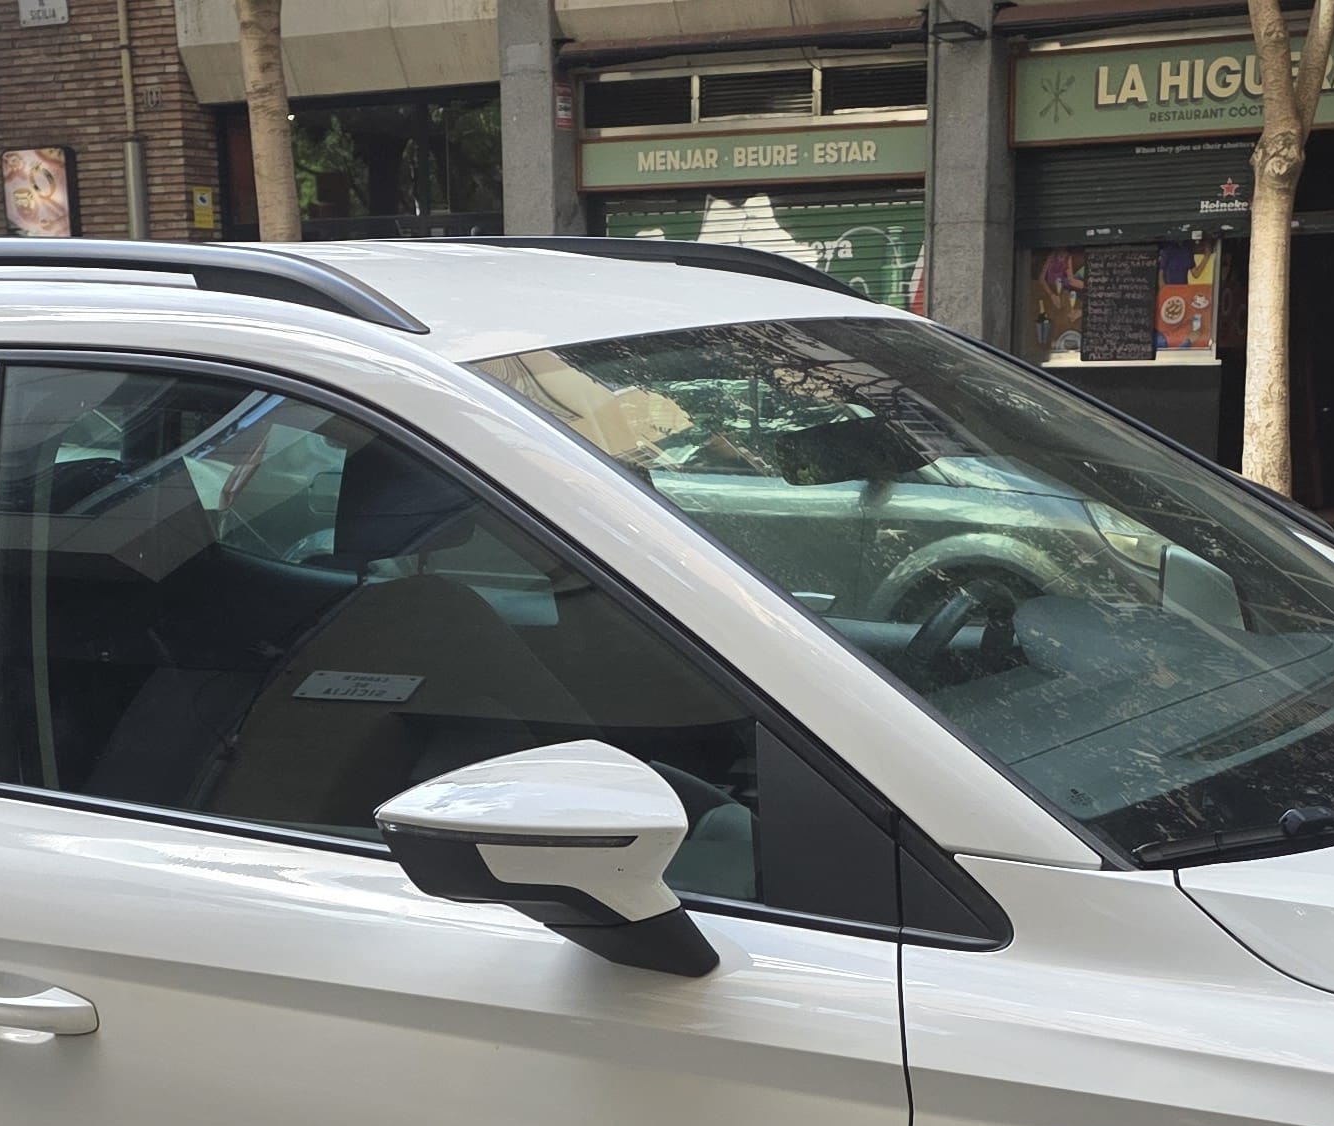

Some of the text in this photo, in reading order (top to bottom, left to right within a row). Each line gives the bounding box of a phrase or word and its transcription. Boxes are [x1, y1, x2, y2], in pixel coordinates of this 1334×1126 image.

[1097, 64, 1148, 105] LA
[1149, 103, 1264, 122] RESTAURANT CÒCT
[637, 141, 877, 172] MENJAR BEURE ESTAR
[1200, 200, 1252, 213] Heineke
